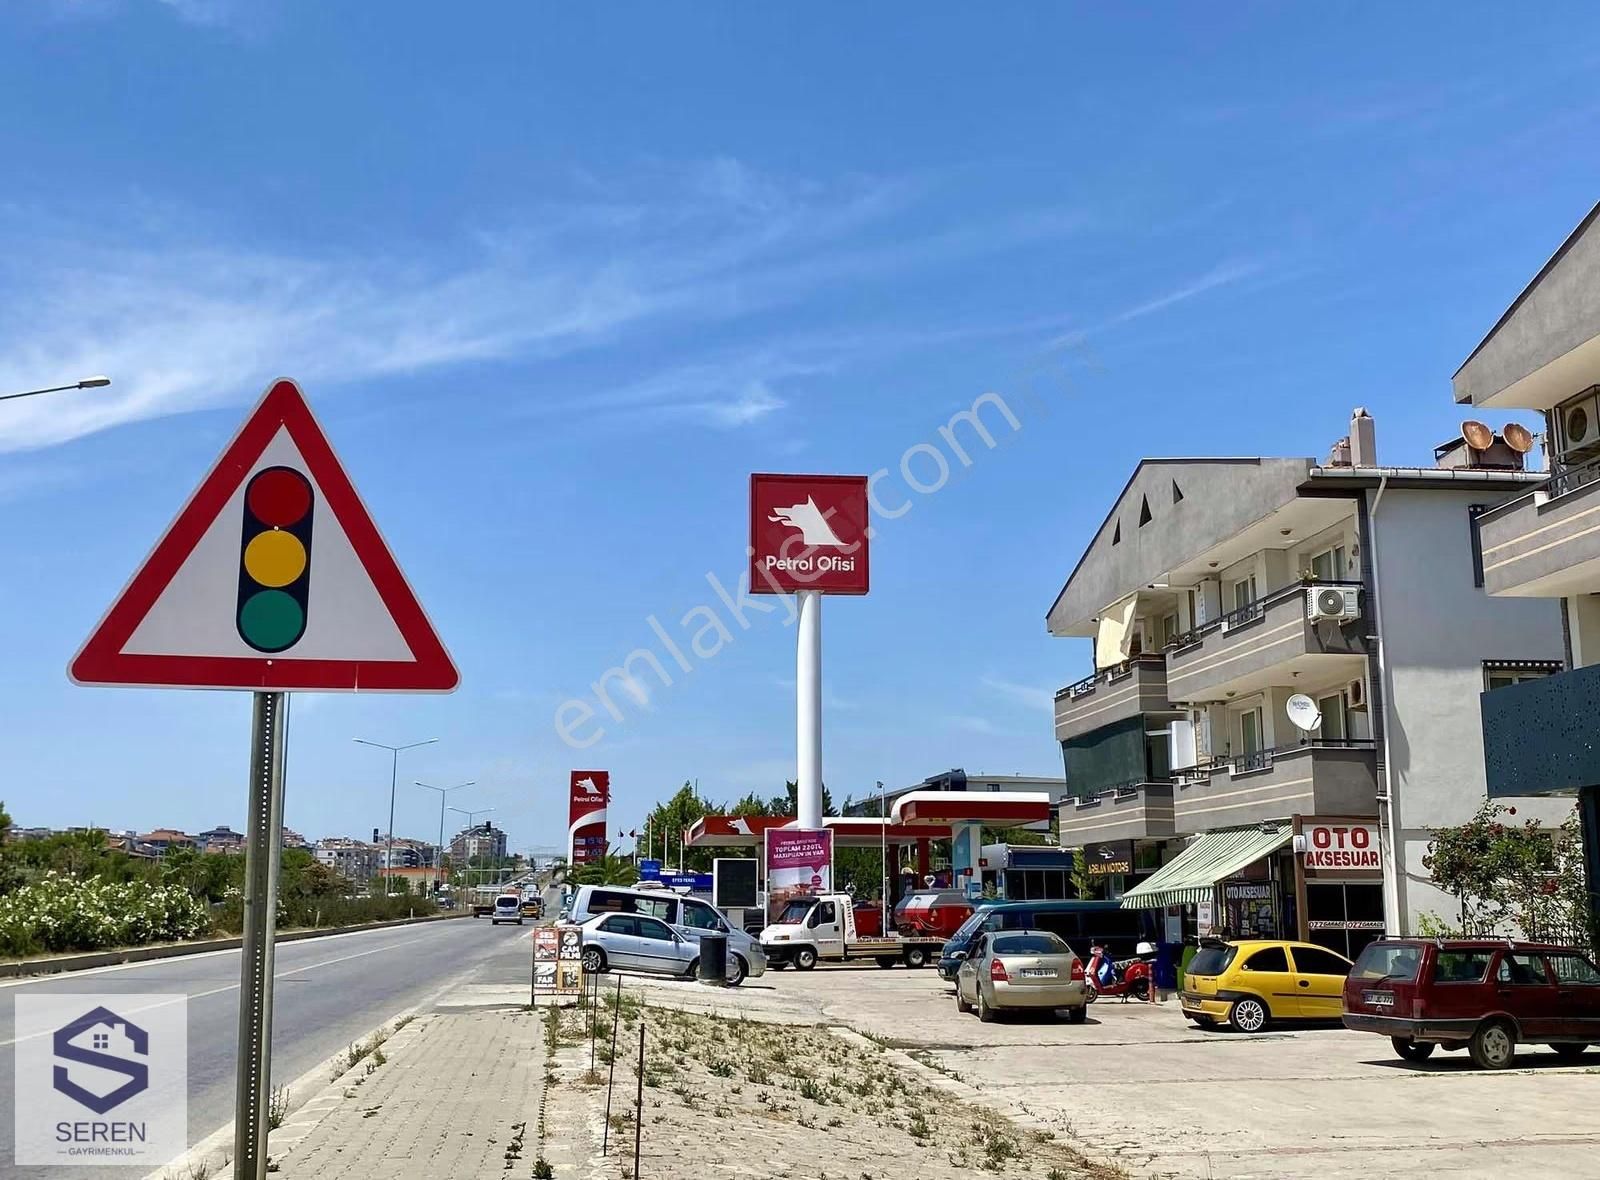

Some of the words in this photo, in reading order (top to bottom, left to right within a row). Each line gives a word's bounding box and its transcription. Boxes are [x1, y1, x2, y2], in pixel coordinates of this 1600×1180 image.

[766, 555, 813, 571] Petrol
[817, 556, 855, 571] Ofisi
[1312, 827, 1369, 849] OTO
[1306, 851, 1379, 866] AKSESUAR
[1108, 861, 1129, 873] MOTORS
[1226, 886, 1238, 899] OTO
[1240, 885, 1271, 899] AKSESUAR
